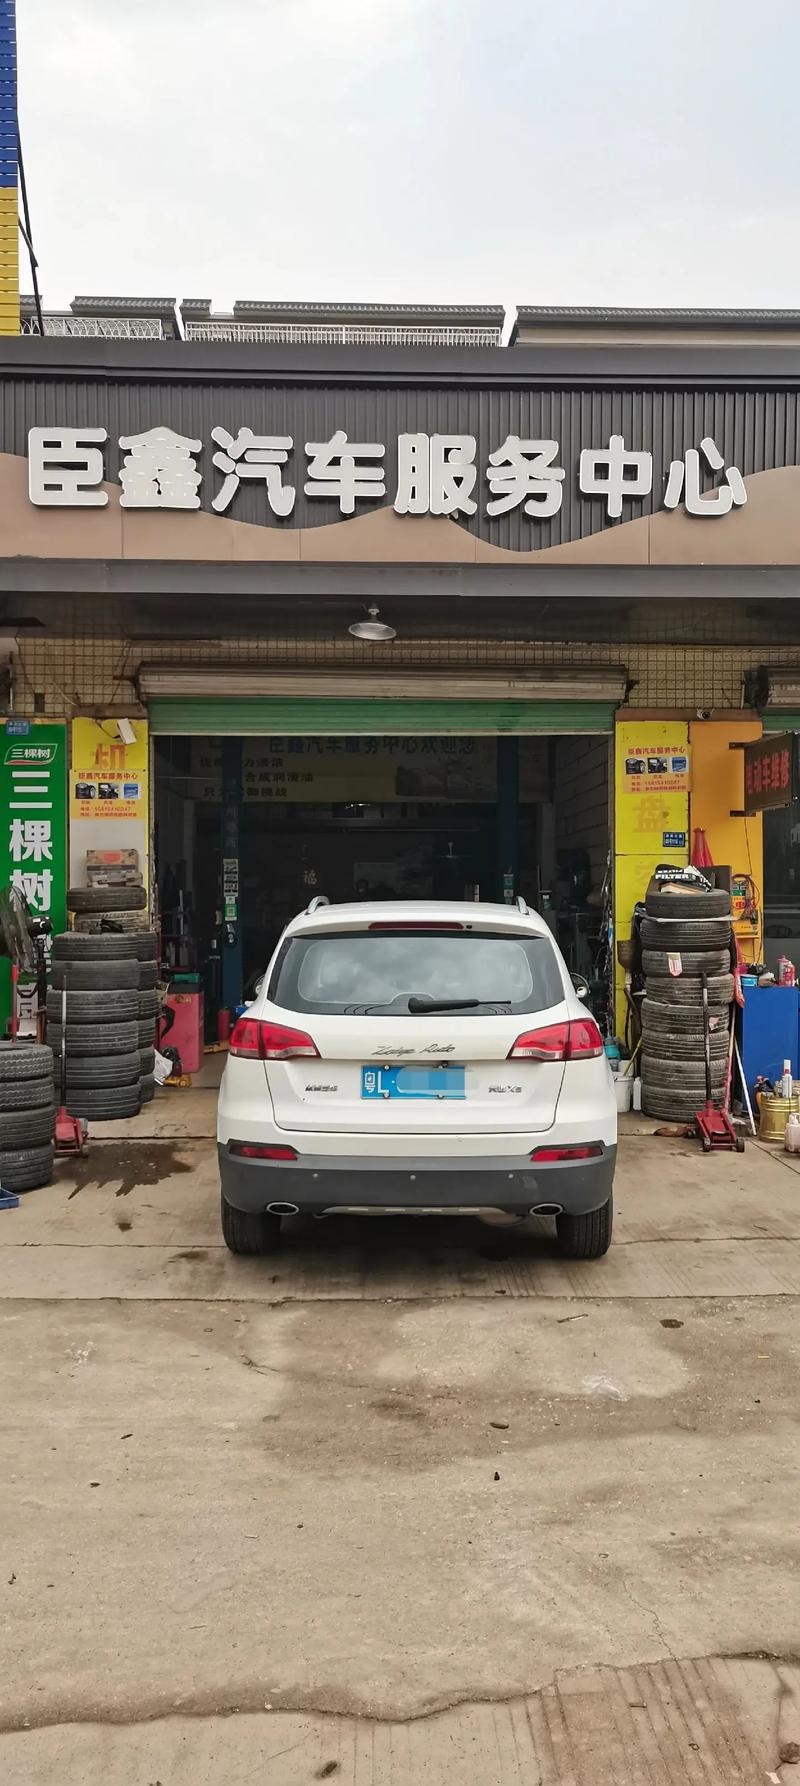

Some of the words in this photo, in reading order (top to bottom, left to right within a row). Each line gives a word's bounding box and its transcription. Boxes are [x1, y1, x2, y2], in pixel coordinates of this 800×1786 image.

[28, 426, 748, 518] 臣鑫汽车服务中心
[11, 748, 51, 759] 三棵树
